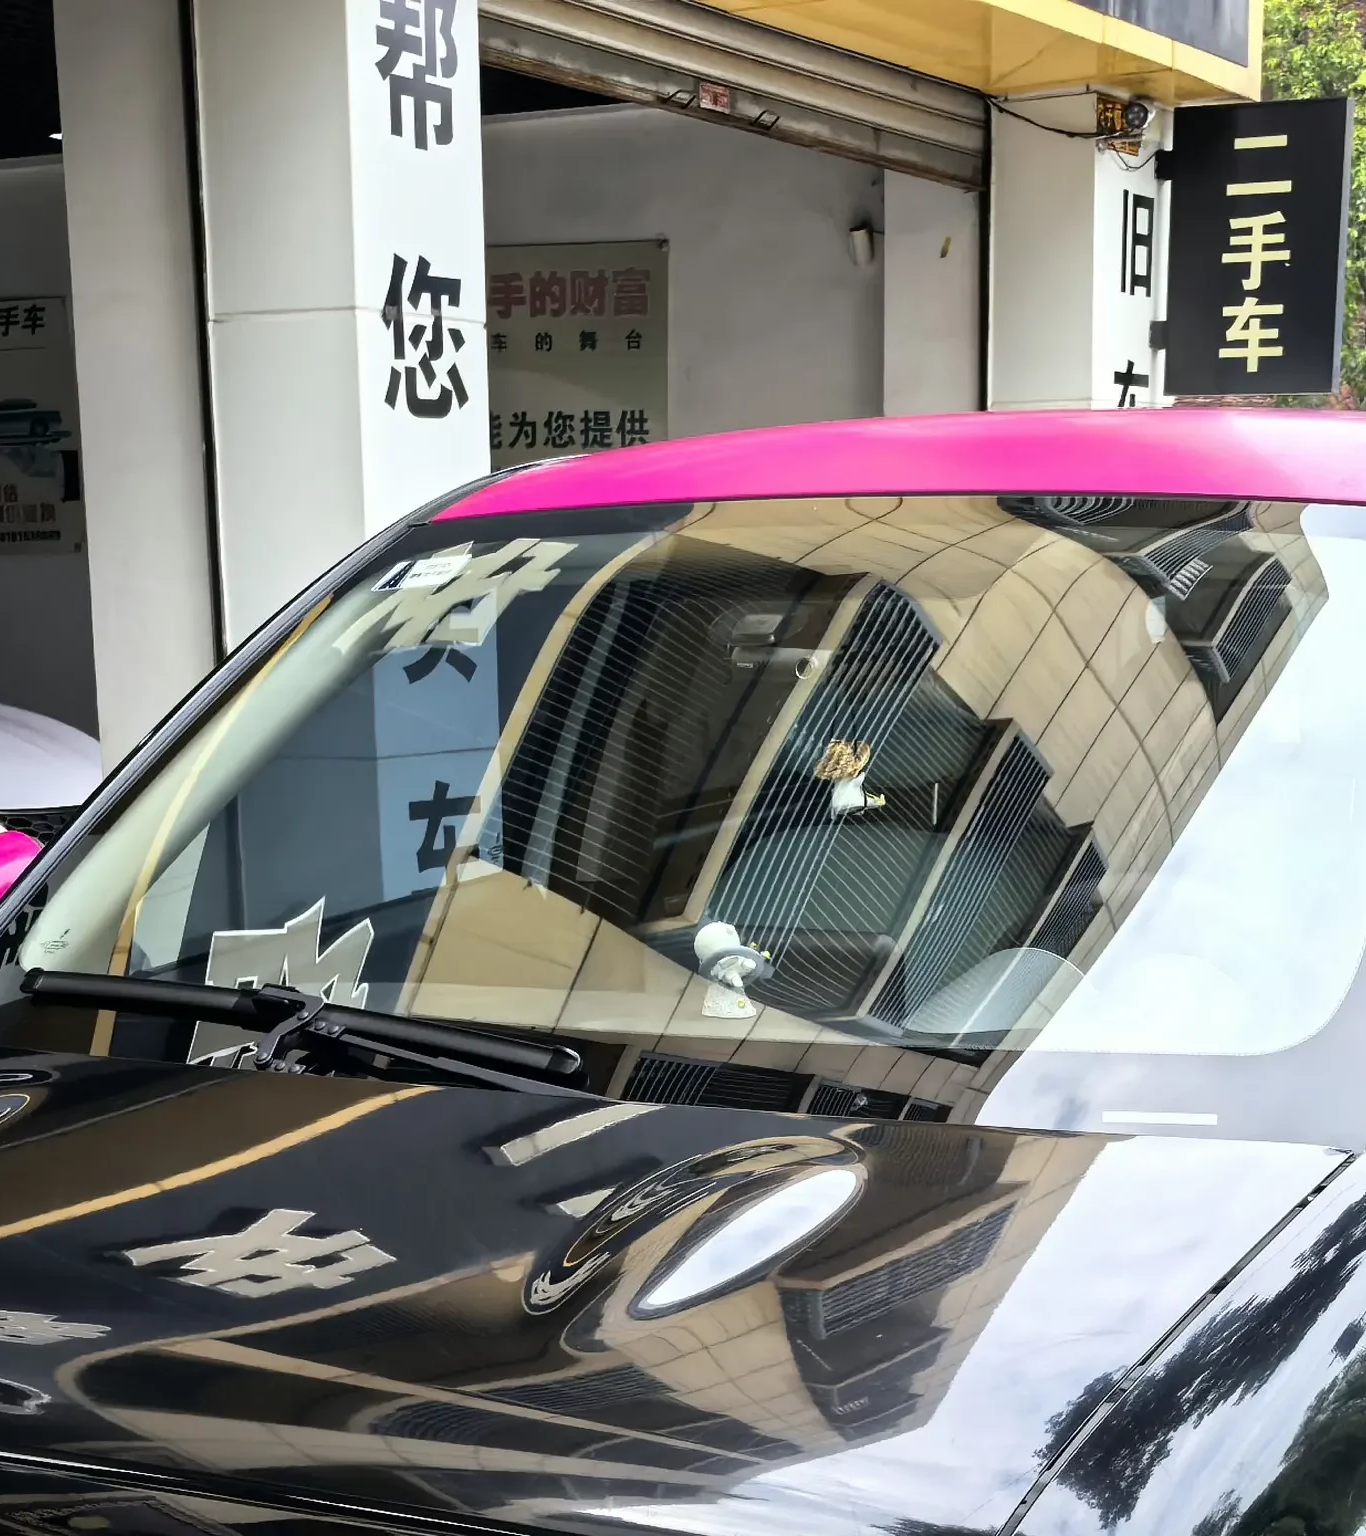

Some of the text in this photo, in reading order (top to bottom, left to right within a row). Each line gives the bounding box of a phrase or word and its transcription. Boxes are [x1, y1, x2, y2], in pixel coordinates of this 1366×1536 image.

[489, 267, 650, 319] 手的财富
[1219, 135, 1292, 372] 二手车
